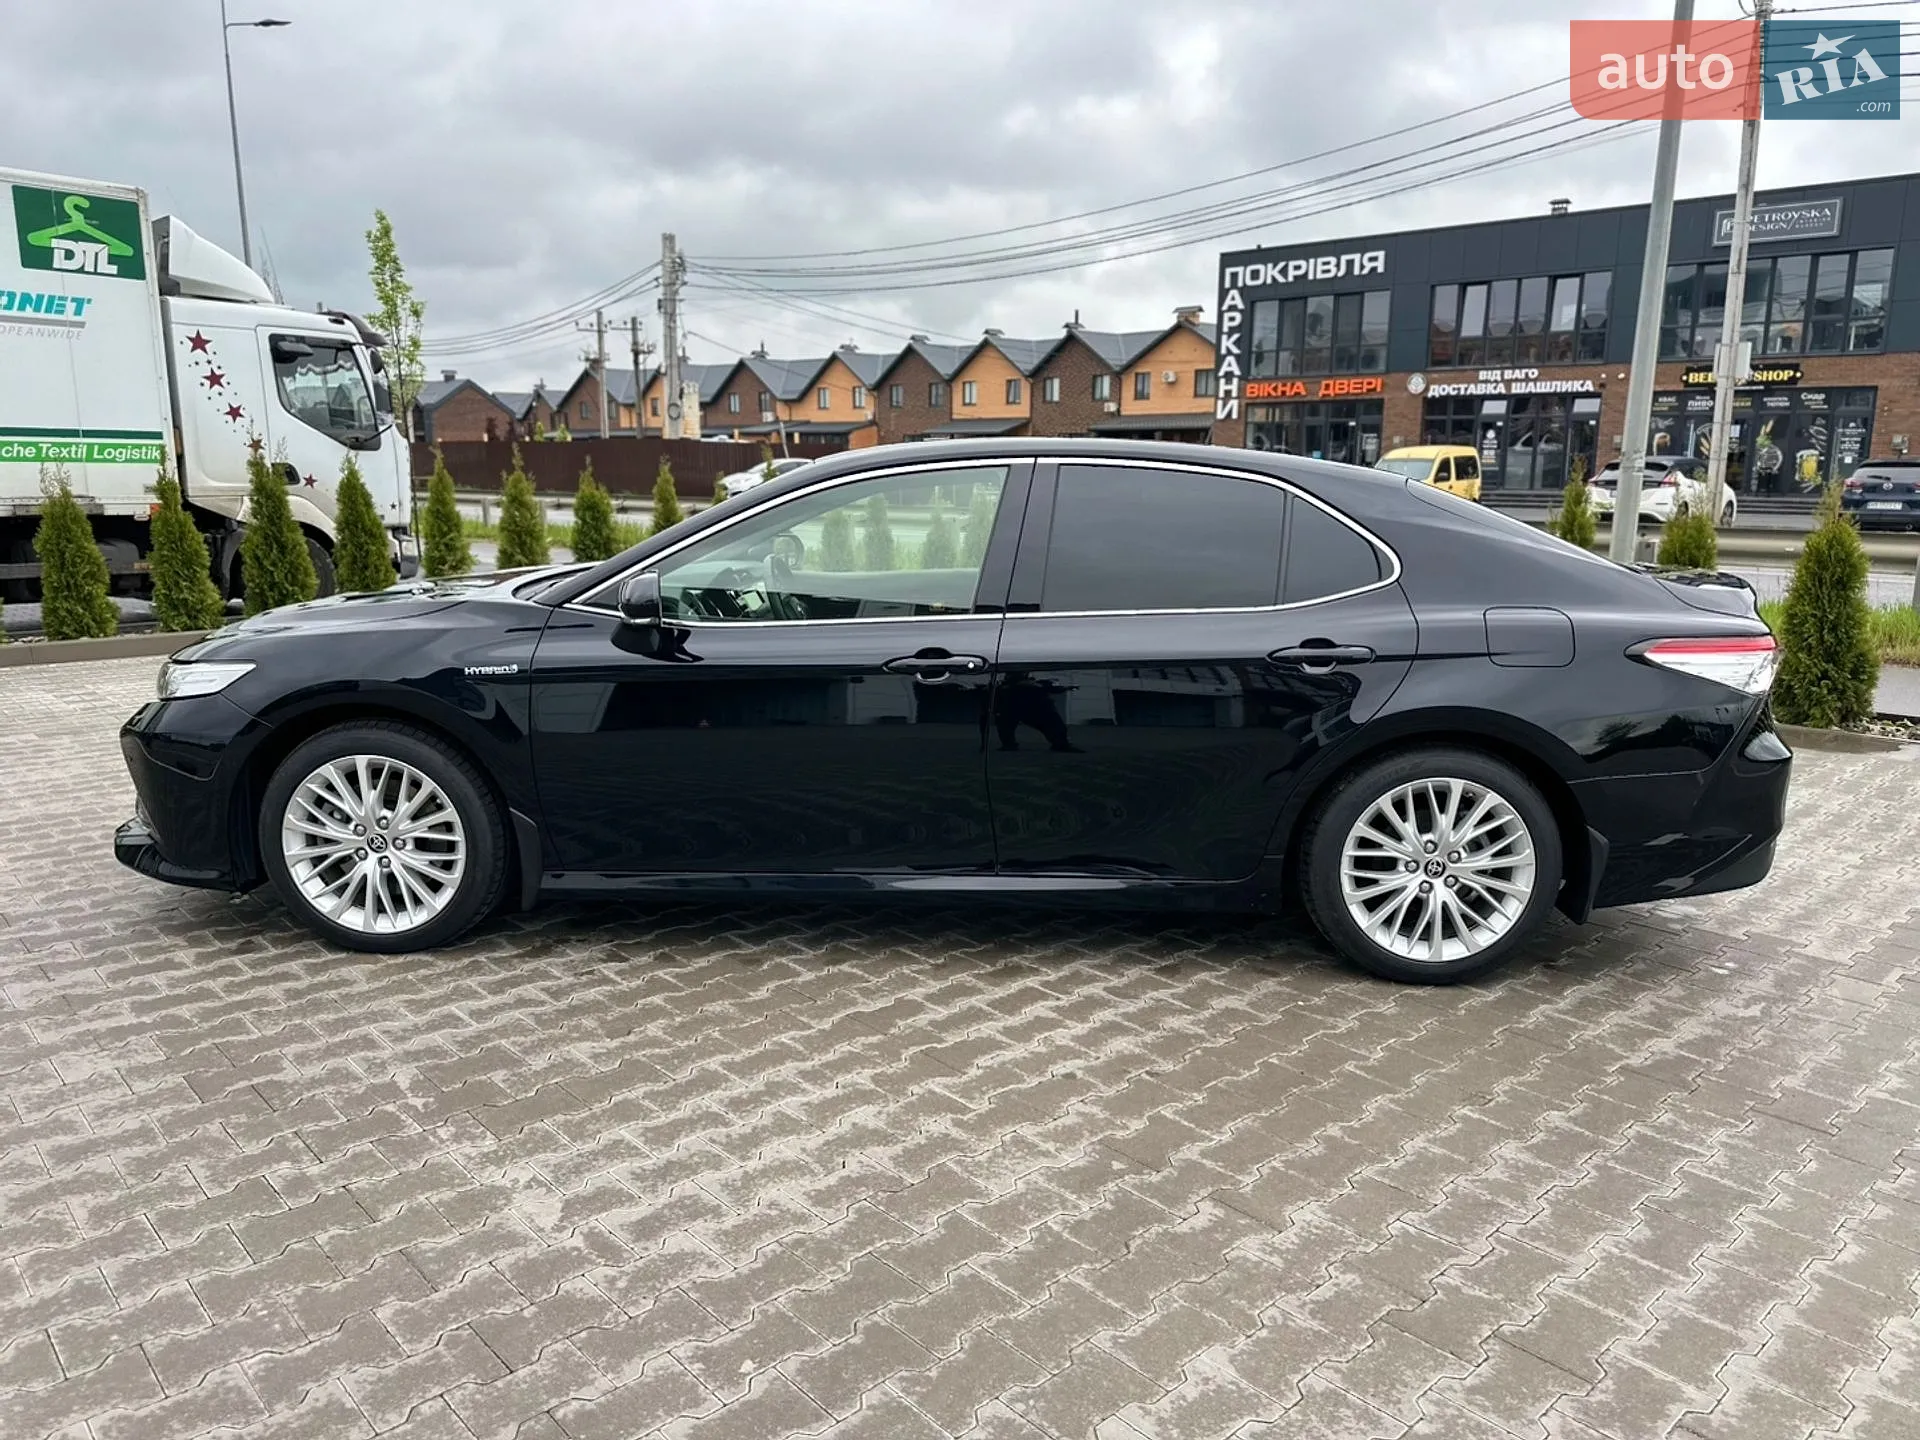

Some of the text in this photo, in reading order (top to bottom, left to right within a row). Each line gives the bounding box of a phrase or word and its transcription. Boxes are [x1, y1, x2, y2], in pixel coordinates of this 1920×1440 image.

[1749, 208, 1831, 223] ETROVSKA
[51, 238, 118, 274] DTL
[1224, 250, 1386, 288] ПОКРІВЛЯ
[1478, 368, 1539, 381] ВІД ВАГО
[1753, 370, 1794, 382] SHOP
[1246, 378, 1383, 398] ВІКНА ДВЕРІ
[1428, 380, 1594, 398] ДОСТАВКА ШАШЛИКА
[1, 443, 161, 462] che Textil Logistik
